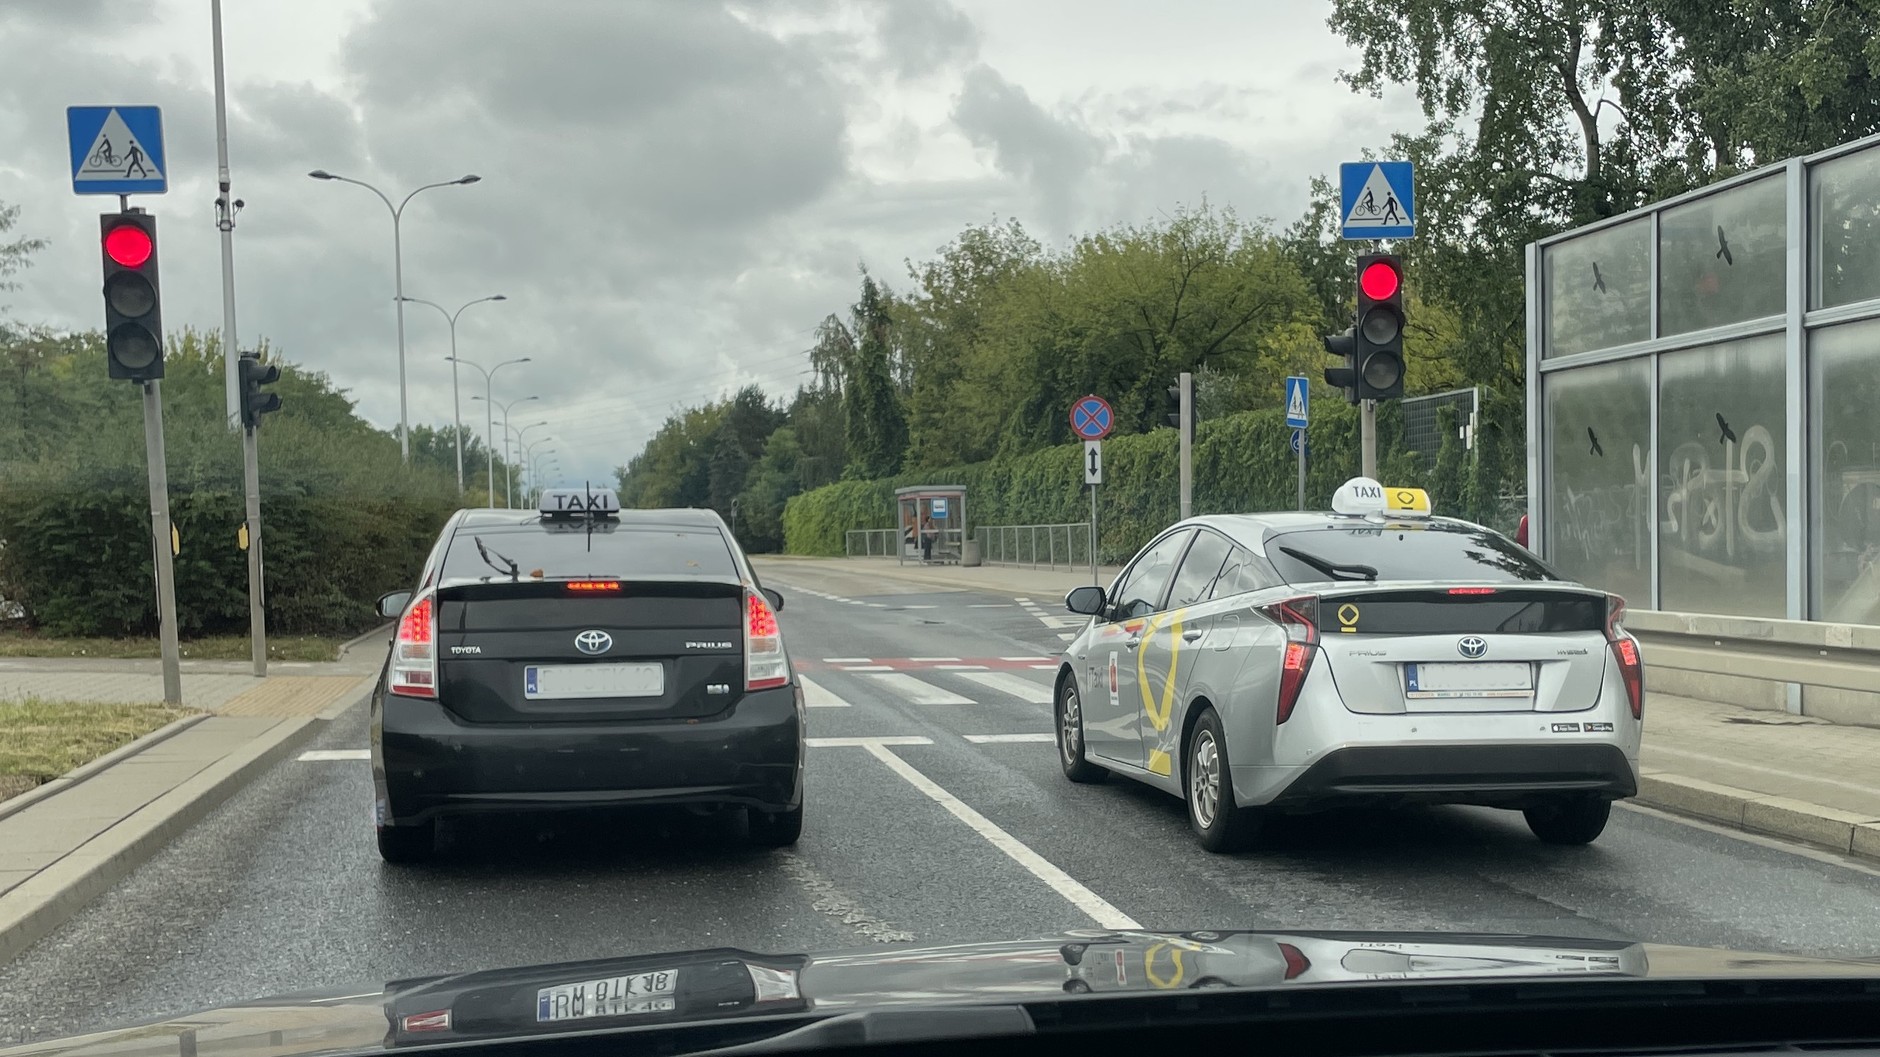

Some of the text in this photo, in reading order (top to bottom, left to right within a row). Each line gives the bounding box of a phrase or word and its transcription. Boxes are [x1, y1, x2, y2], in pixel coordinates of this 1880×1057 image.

[1353, 486, 1382, 498] TAXI
[552, 494, 608, 510] TAXI
[450, 646, 482, 654] TOYOTA
[527, 683, 537, 692] PL
